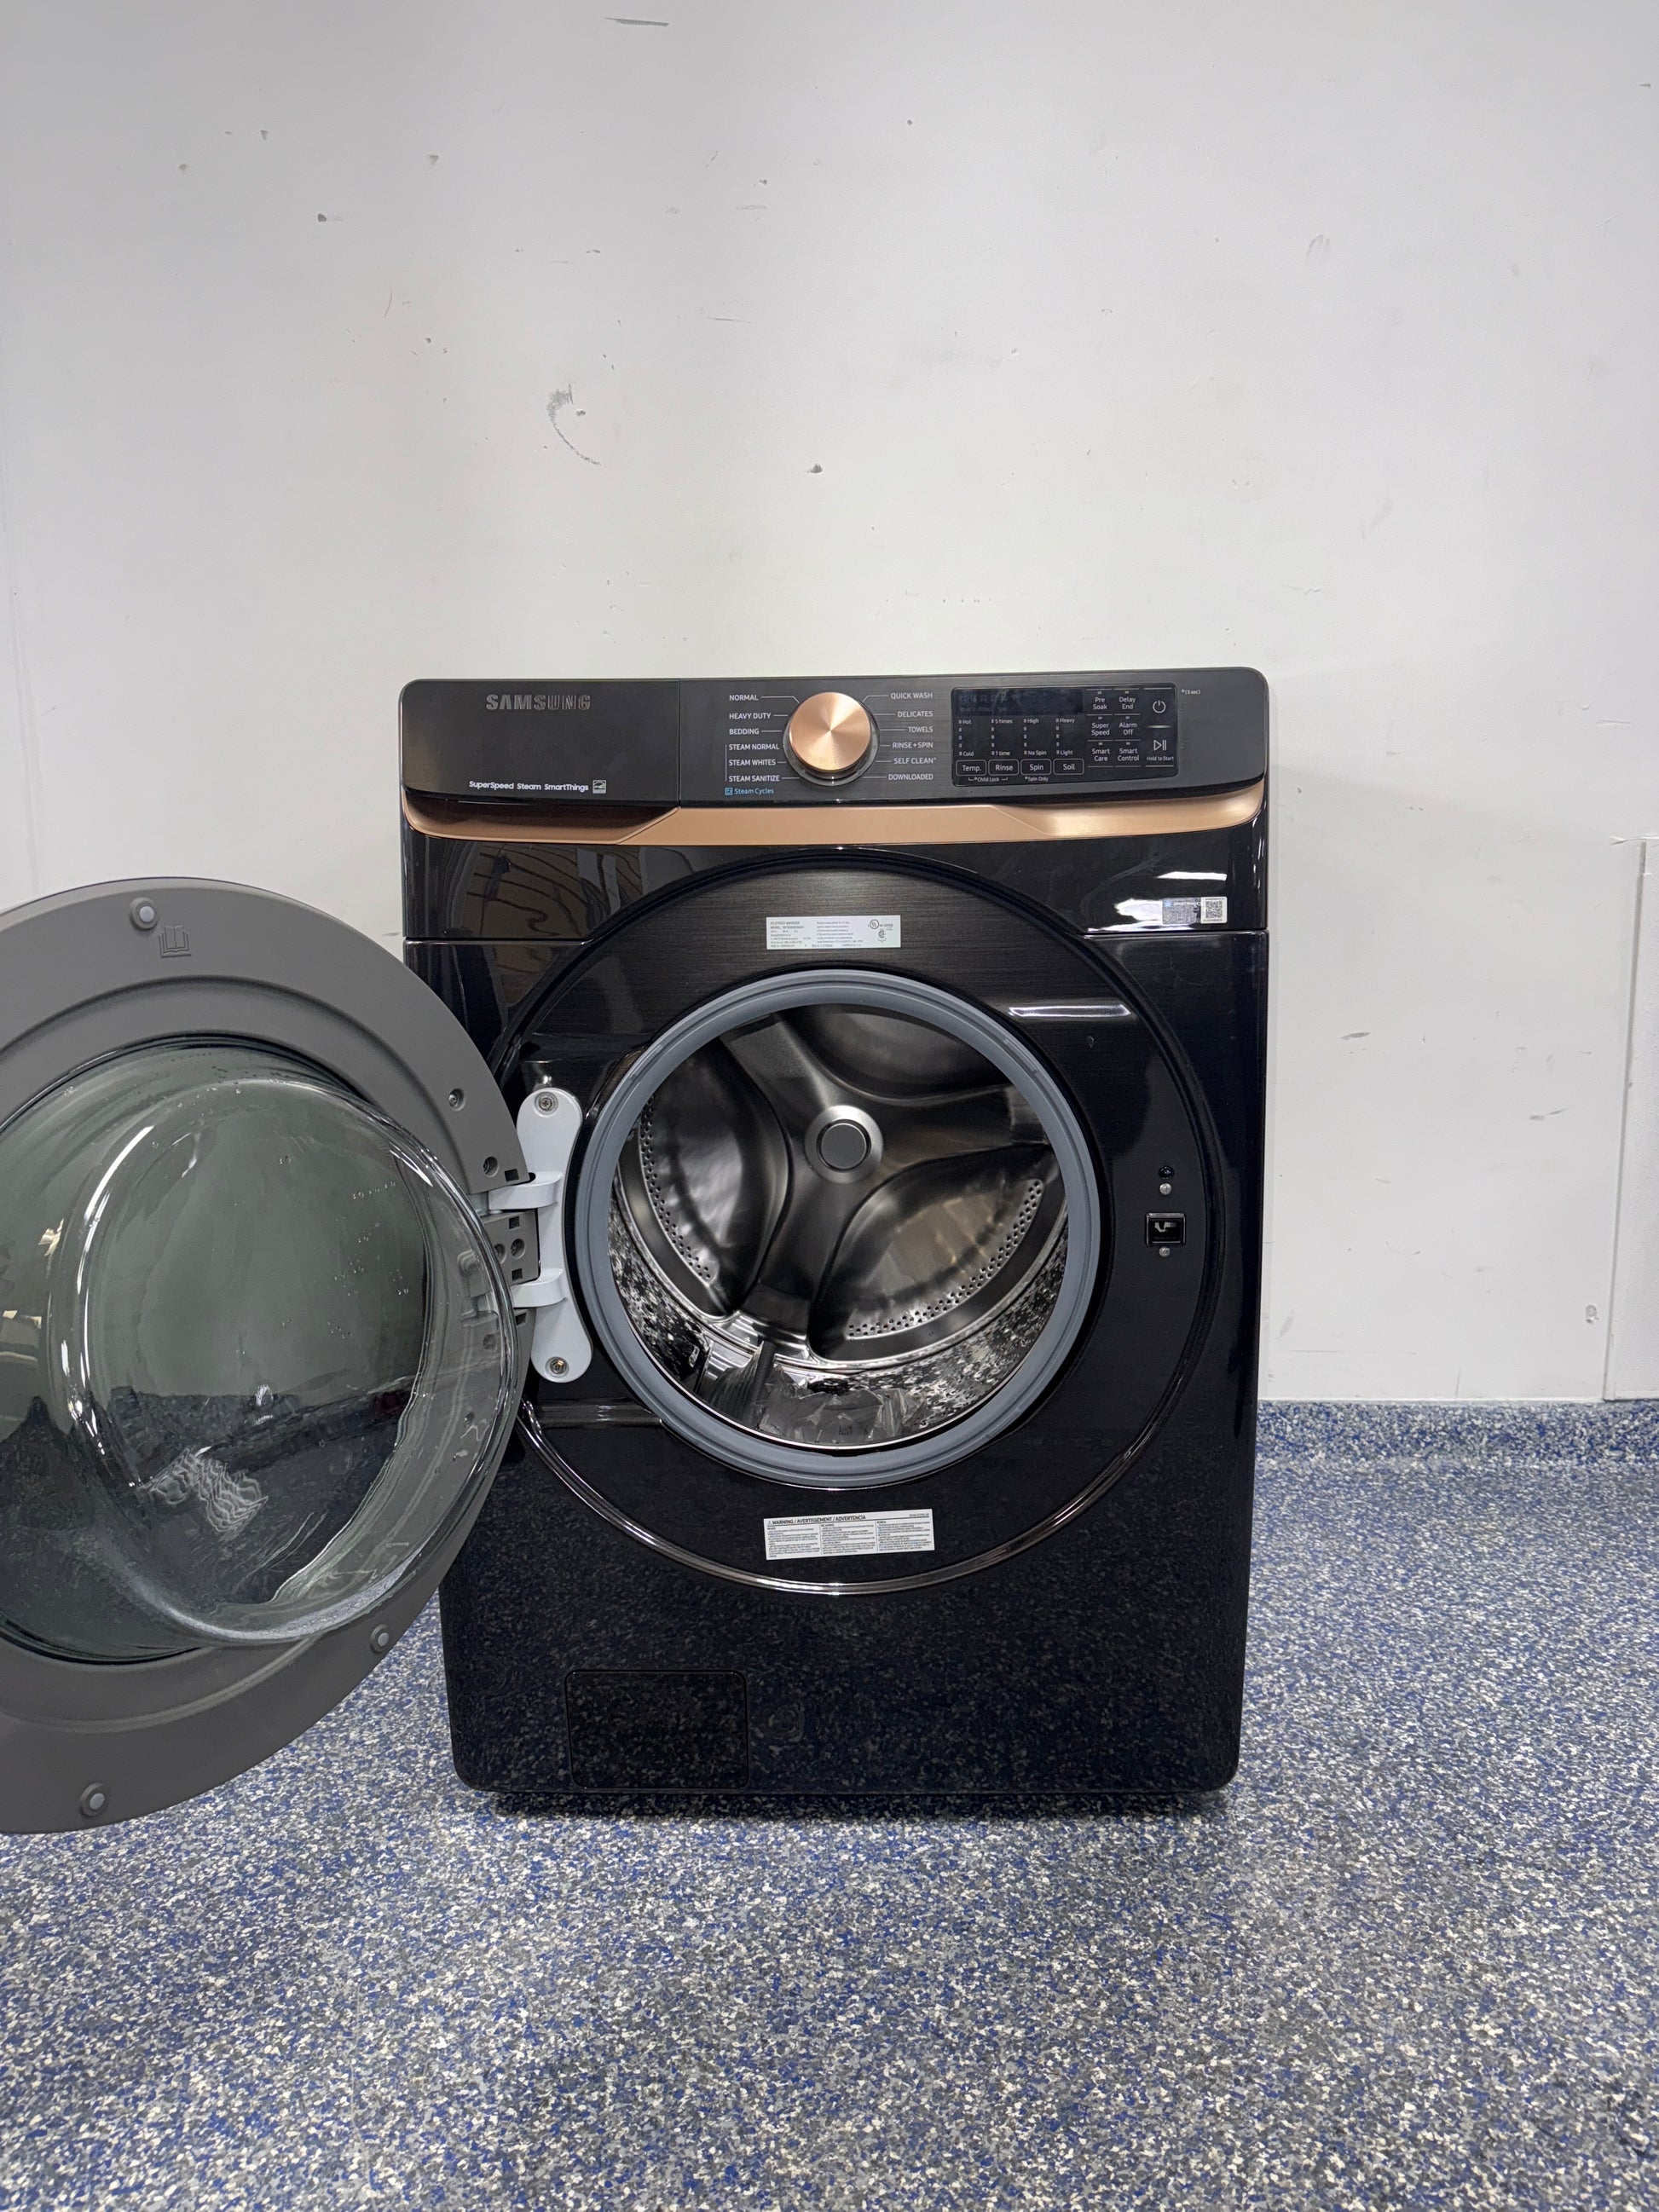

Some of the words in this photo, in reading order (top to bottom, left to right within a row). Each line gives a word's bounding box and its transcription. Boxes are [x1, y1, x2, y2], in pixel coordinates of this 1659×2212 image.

[486, 694, 591, 711] SAMSUNG
[962, 765, 982, 773] Temp.
[1029, 764, 1044, 772] Spin
[469, 781, 514, 790] SuperSpeed
[544, 783, 589, 793] SmartThings
